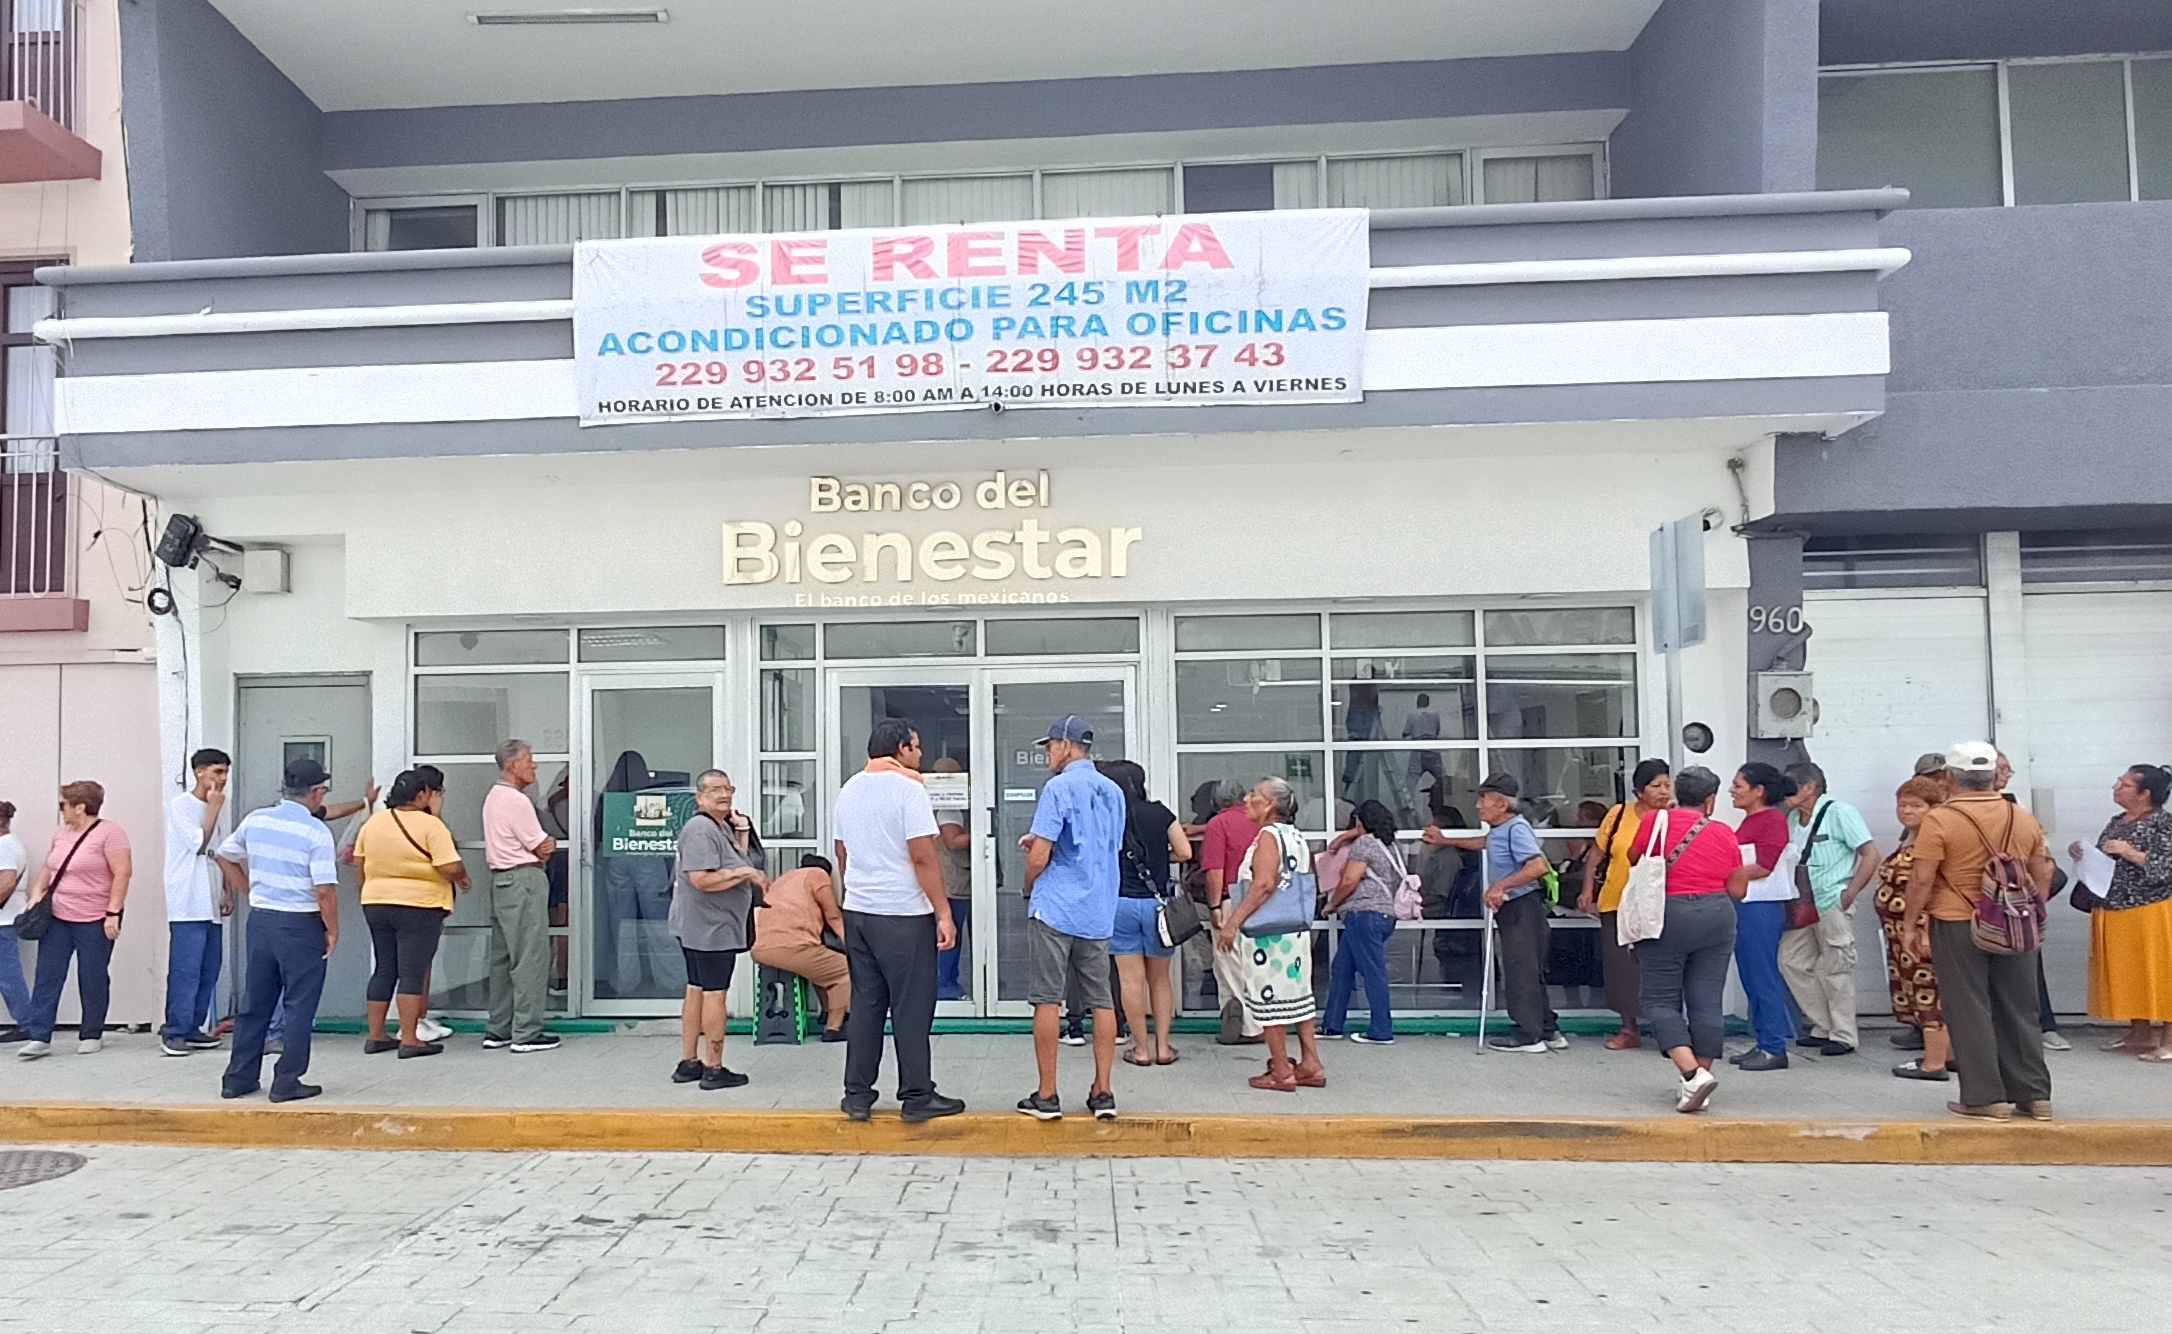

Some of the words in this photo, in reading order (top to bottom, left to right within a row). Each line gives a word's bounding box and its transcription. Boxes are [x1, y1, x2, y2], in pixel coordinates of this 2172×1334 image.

[701, 240, 828, 289] SE
[871, 224, 1235, 282] RENTA
[745, 285, 1013, 318] SUPERFICIE
[1027, 281, 1105, 306] 245
[1125, 279, 1188, 303] M2
[597, 317, 974, 357] ACONDICIONADO
[992, 313, 1109, 340] PARA
[1126, 306, 1347, 336] OFICINAS
[655, 362, 728, 388] 229
[742, 357, 817, 384] 932
[832, 354, 877, 380] 51
[895, 352, 944, 377] 98
[986, 348, 1060, 373] 229
[1076, 345, 1152, 371] 932
[1168, 343, 1219, 367] 37
[1233, 341, 1286, 367] 43
[599, 397, 690, 413] HORARIO
[697, 396, 723, 410] DE
[731, 393, 833, 409] ATENCION
[841, 391, 867, 406] DE
[874, 389, 916, 404] 8:00
[922, 388, 954, 402] AM
[960, 387, 974, 400] A
[981, 384, 1034, 398] 14:00
[1041, 382, 1113, 397] HORAS
[1121, 381, 1148, 395] DE
[1155, 380, 1225, 395] LUNES
[1232, 380, 1246, 394] A
[1254, 377, 1347, 393] VIERNES
[810, 476, 961, 512] Banco
[976, 470, 1050, 509] del
[721, 519, 1143, 585] Bienestar
[795, 593, 812, 606] El
[820, 593, 881, 607] banco
[889, 591, 914, 606] de
[922, 591, 951, 605] los
[958, 587, 1069, 604] mexicanos
[1750, 606, 1803, 633] 960
